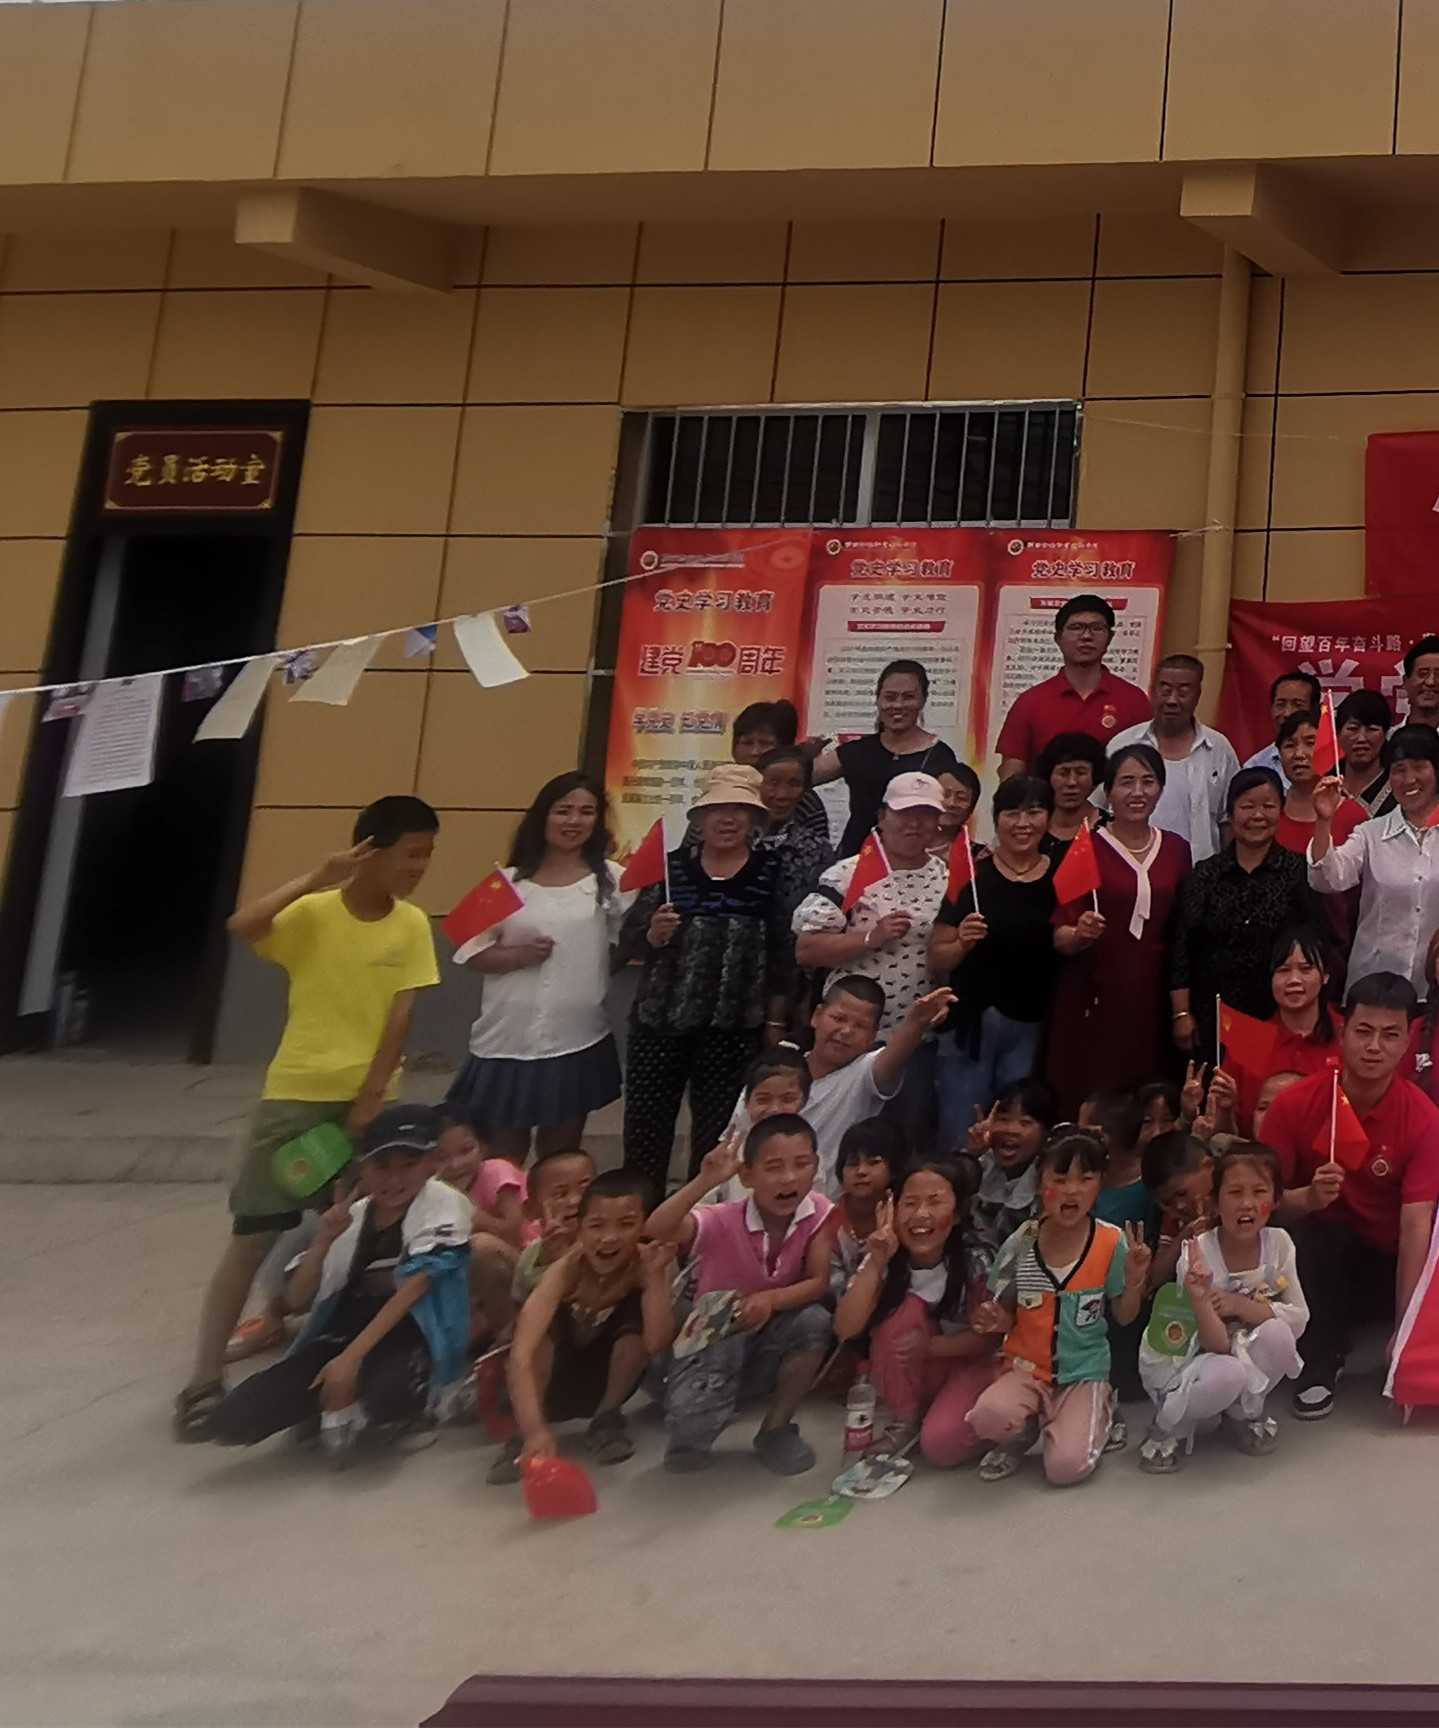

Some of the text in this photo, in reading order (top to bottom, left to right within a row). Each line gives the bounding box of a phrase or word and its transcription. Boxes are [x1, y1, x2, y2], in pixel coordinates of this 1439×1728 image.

[124, 453, 267, 486] 党员活动室
[850, 559, 954, 578] 党史学习教育
[1031, 559, 1136, 579] 党史学习教育
[653, 589, 775, 613] 党史学习教育
